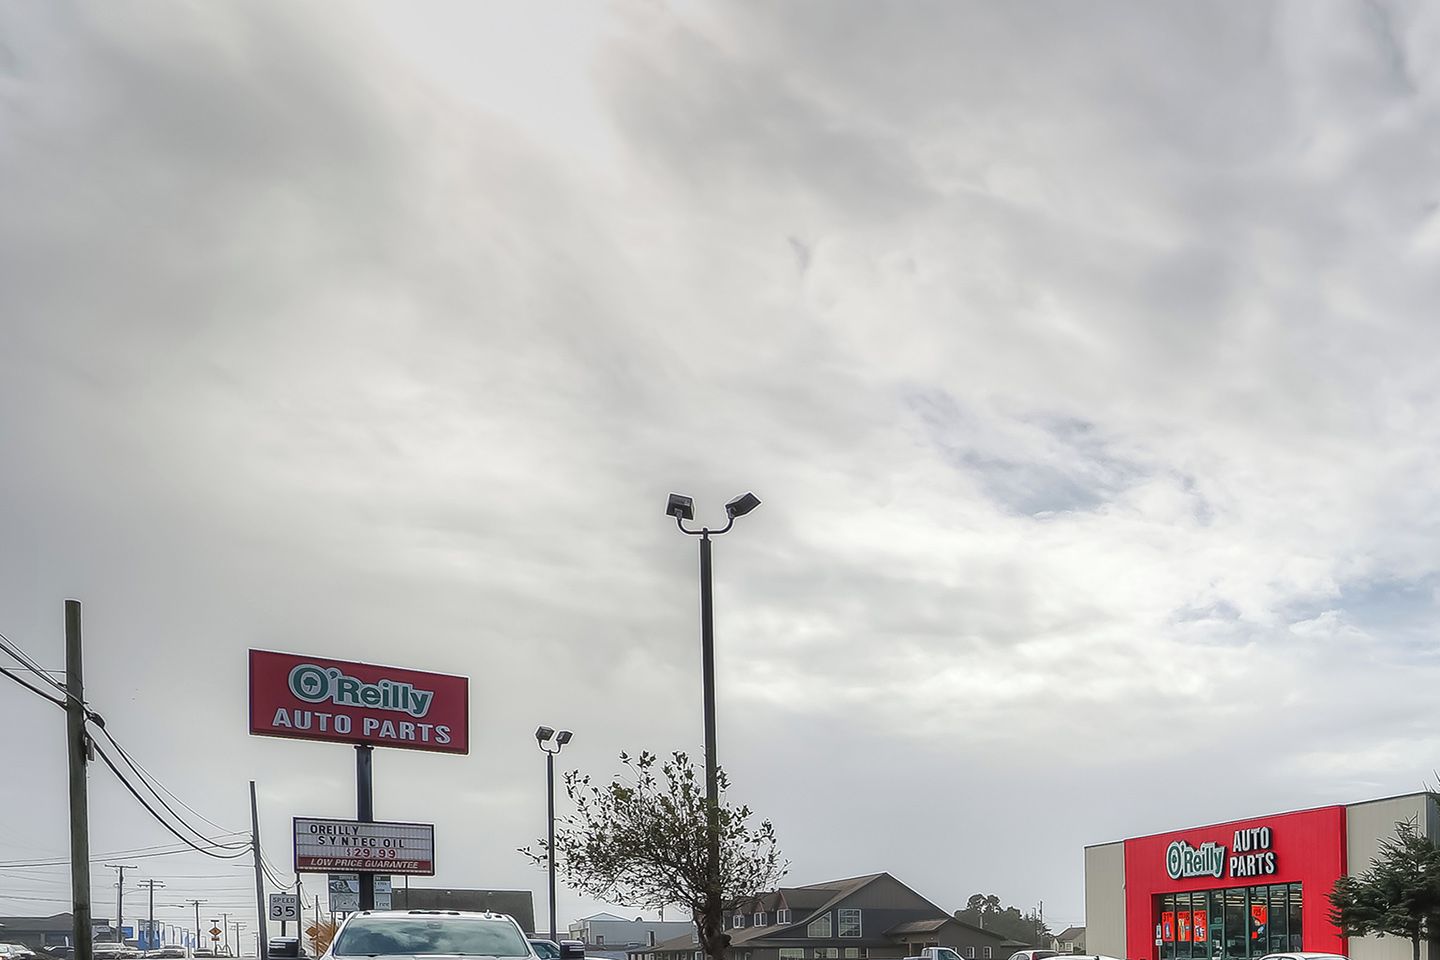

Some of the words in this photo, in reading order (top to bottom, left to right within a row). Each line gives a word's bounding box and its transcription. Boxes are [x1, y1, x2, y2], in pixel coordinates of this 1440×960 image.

[289, 664, 433, 718] O'Reilly
[272, 708, 352, 734] AUTO
[363, 718, 450, 744] PARTS
[310, 825, 359, 835] OREILLY
[318, 836, 376, 847] SYNTEC
[383, 839, 404, 848] OIL
[1233, 827, 1270, 852] AUTO
[346, 848, 396, 858] $29.99
[1166, 841, 1226, 879] O'Reilly
[310, 858, 333, 866] LOW
[335, 859, 362, 867] PRICE
[365, 860, 418, 869] GUARANTEE
[1230, 852, 1276, 877] PARTS
[272, 906, 295, 917] 35
